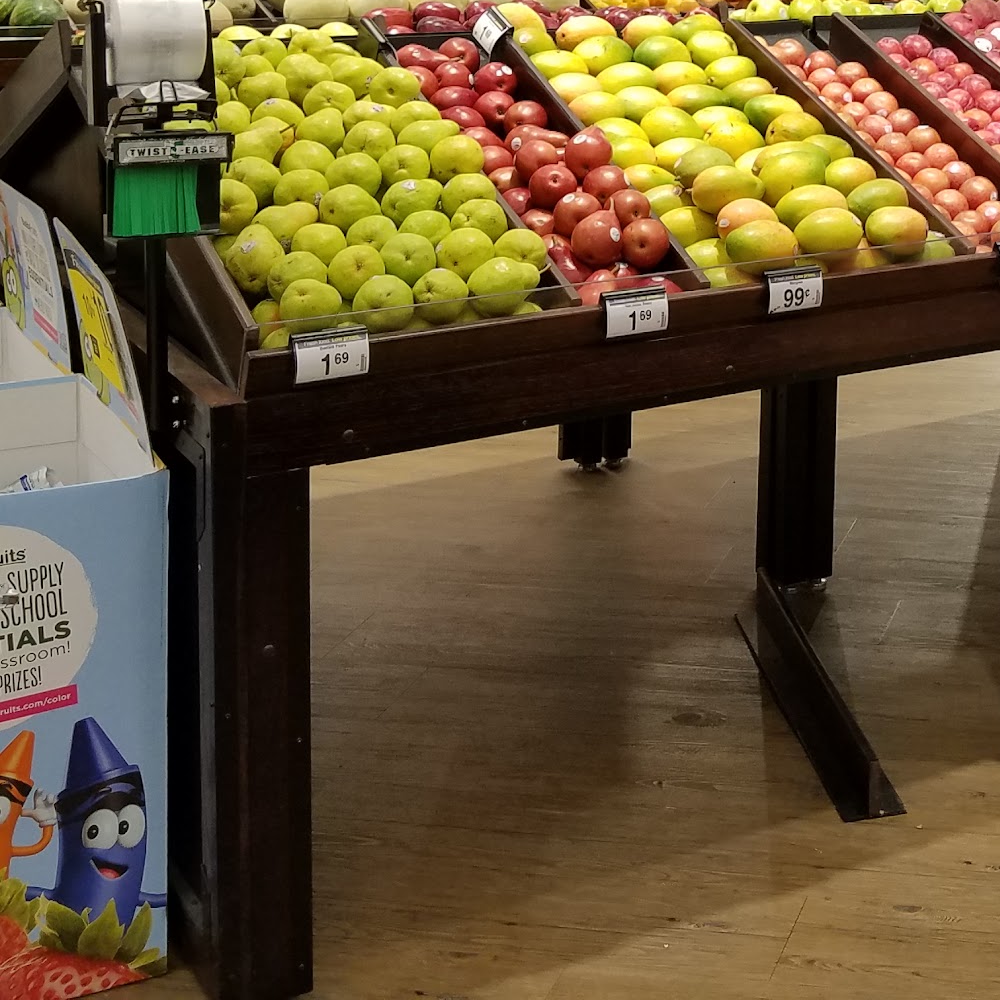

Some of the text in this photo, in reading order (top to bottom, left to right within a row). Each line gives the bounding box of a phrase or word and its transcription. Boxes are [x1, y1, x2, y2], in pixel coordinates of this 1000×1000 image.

[784, 287, 810, 308] 99¢
[7, 561, 64, 594] SUPPLY
[0, 588, 68, 629] SCHOOL
[0, 640, 70, 669] ssroom!
[0, 692, 71, 716] ruits.com/color
